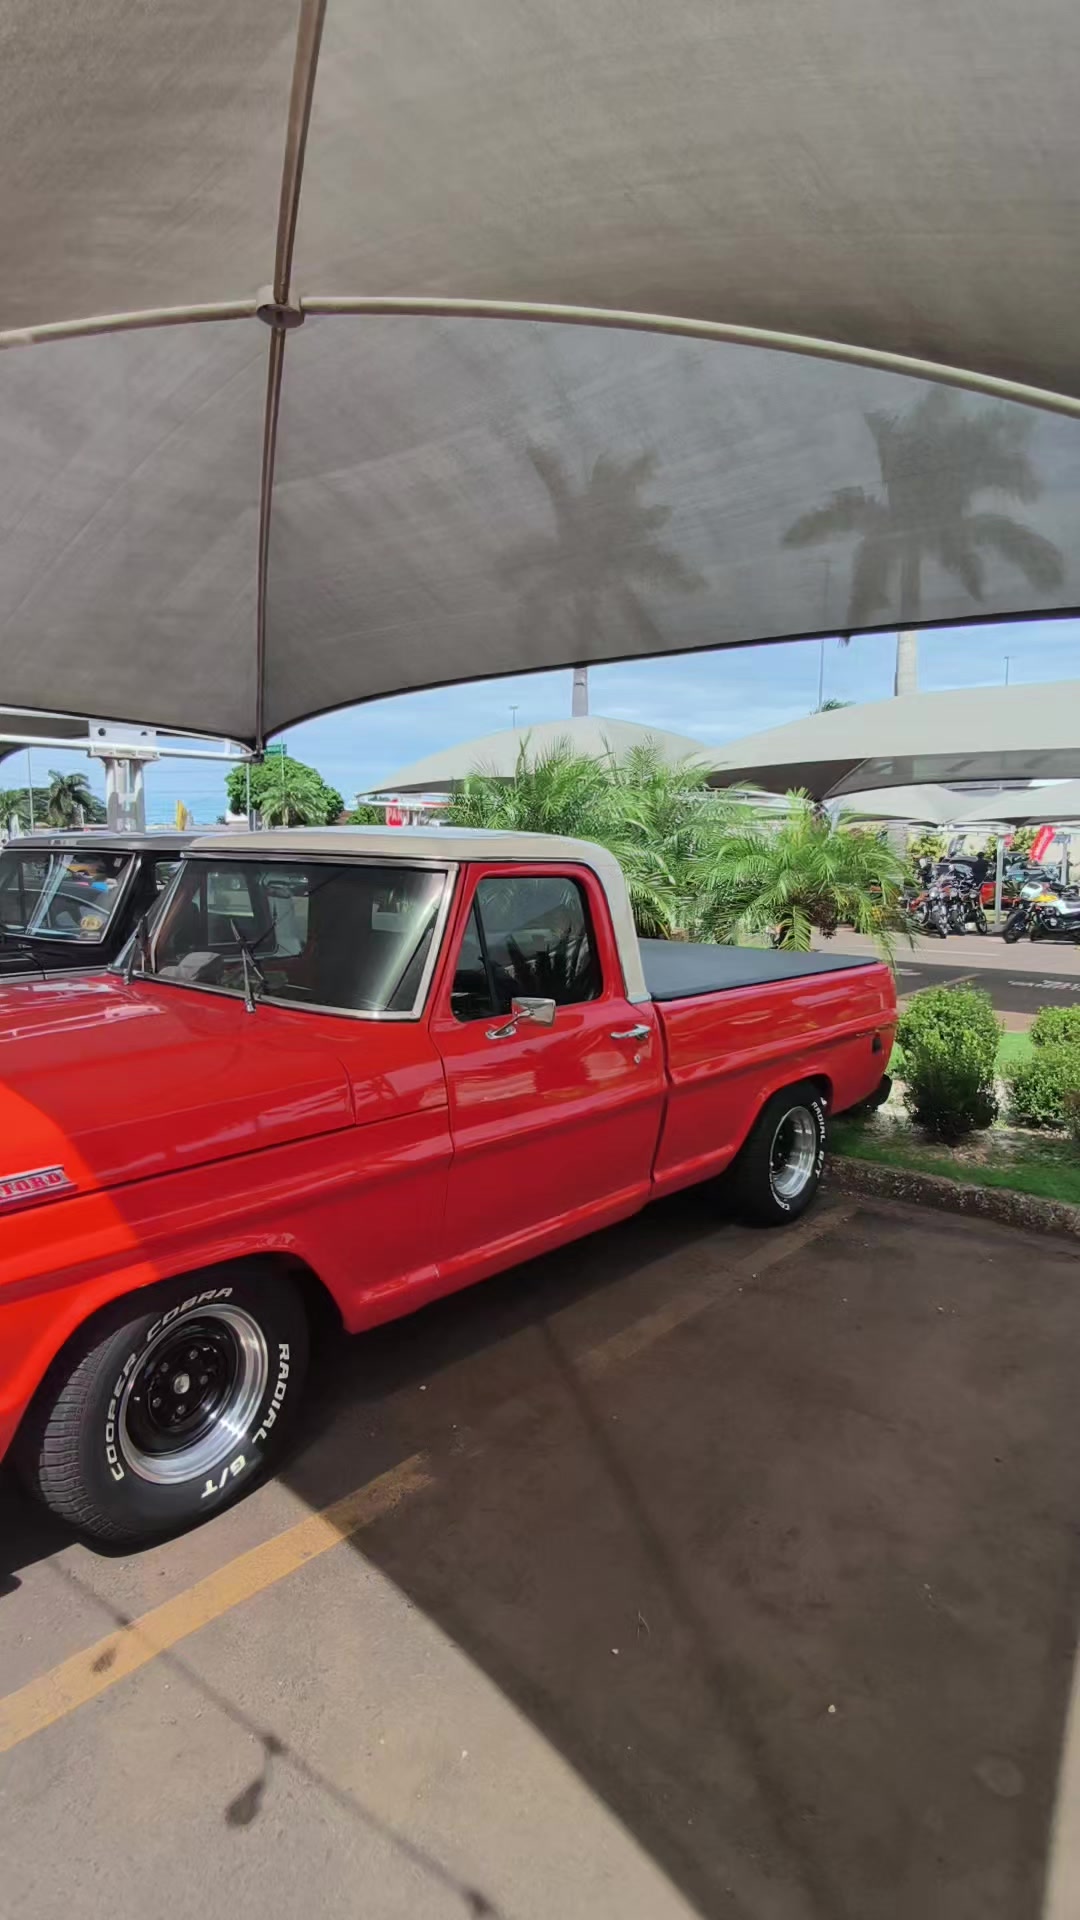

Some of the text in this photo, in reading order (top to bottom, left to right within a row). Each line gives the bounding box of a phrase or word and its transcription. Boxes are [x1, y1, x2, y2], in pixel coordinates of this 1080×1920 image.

[1, 1172, 62, 1196] FORD
[105, 1353, 137, 1480] COOPER
[146, 1287, 233, 1342] COBRA
[251, 1343, 290, 1444] RADIAL
